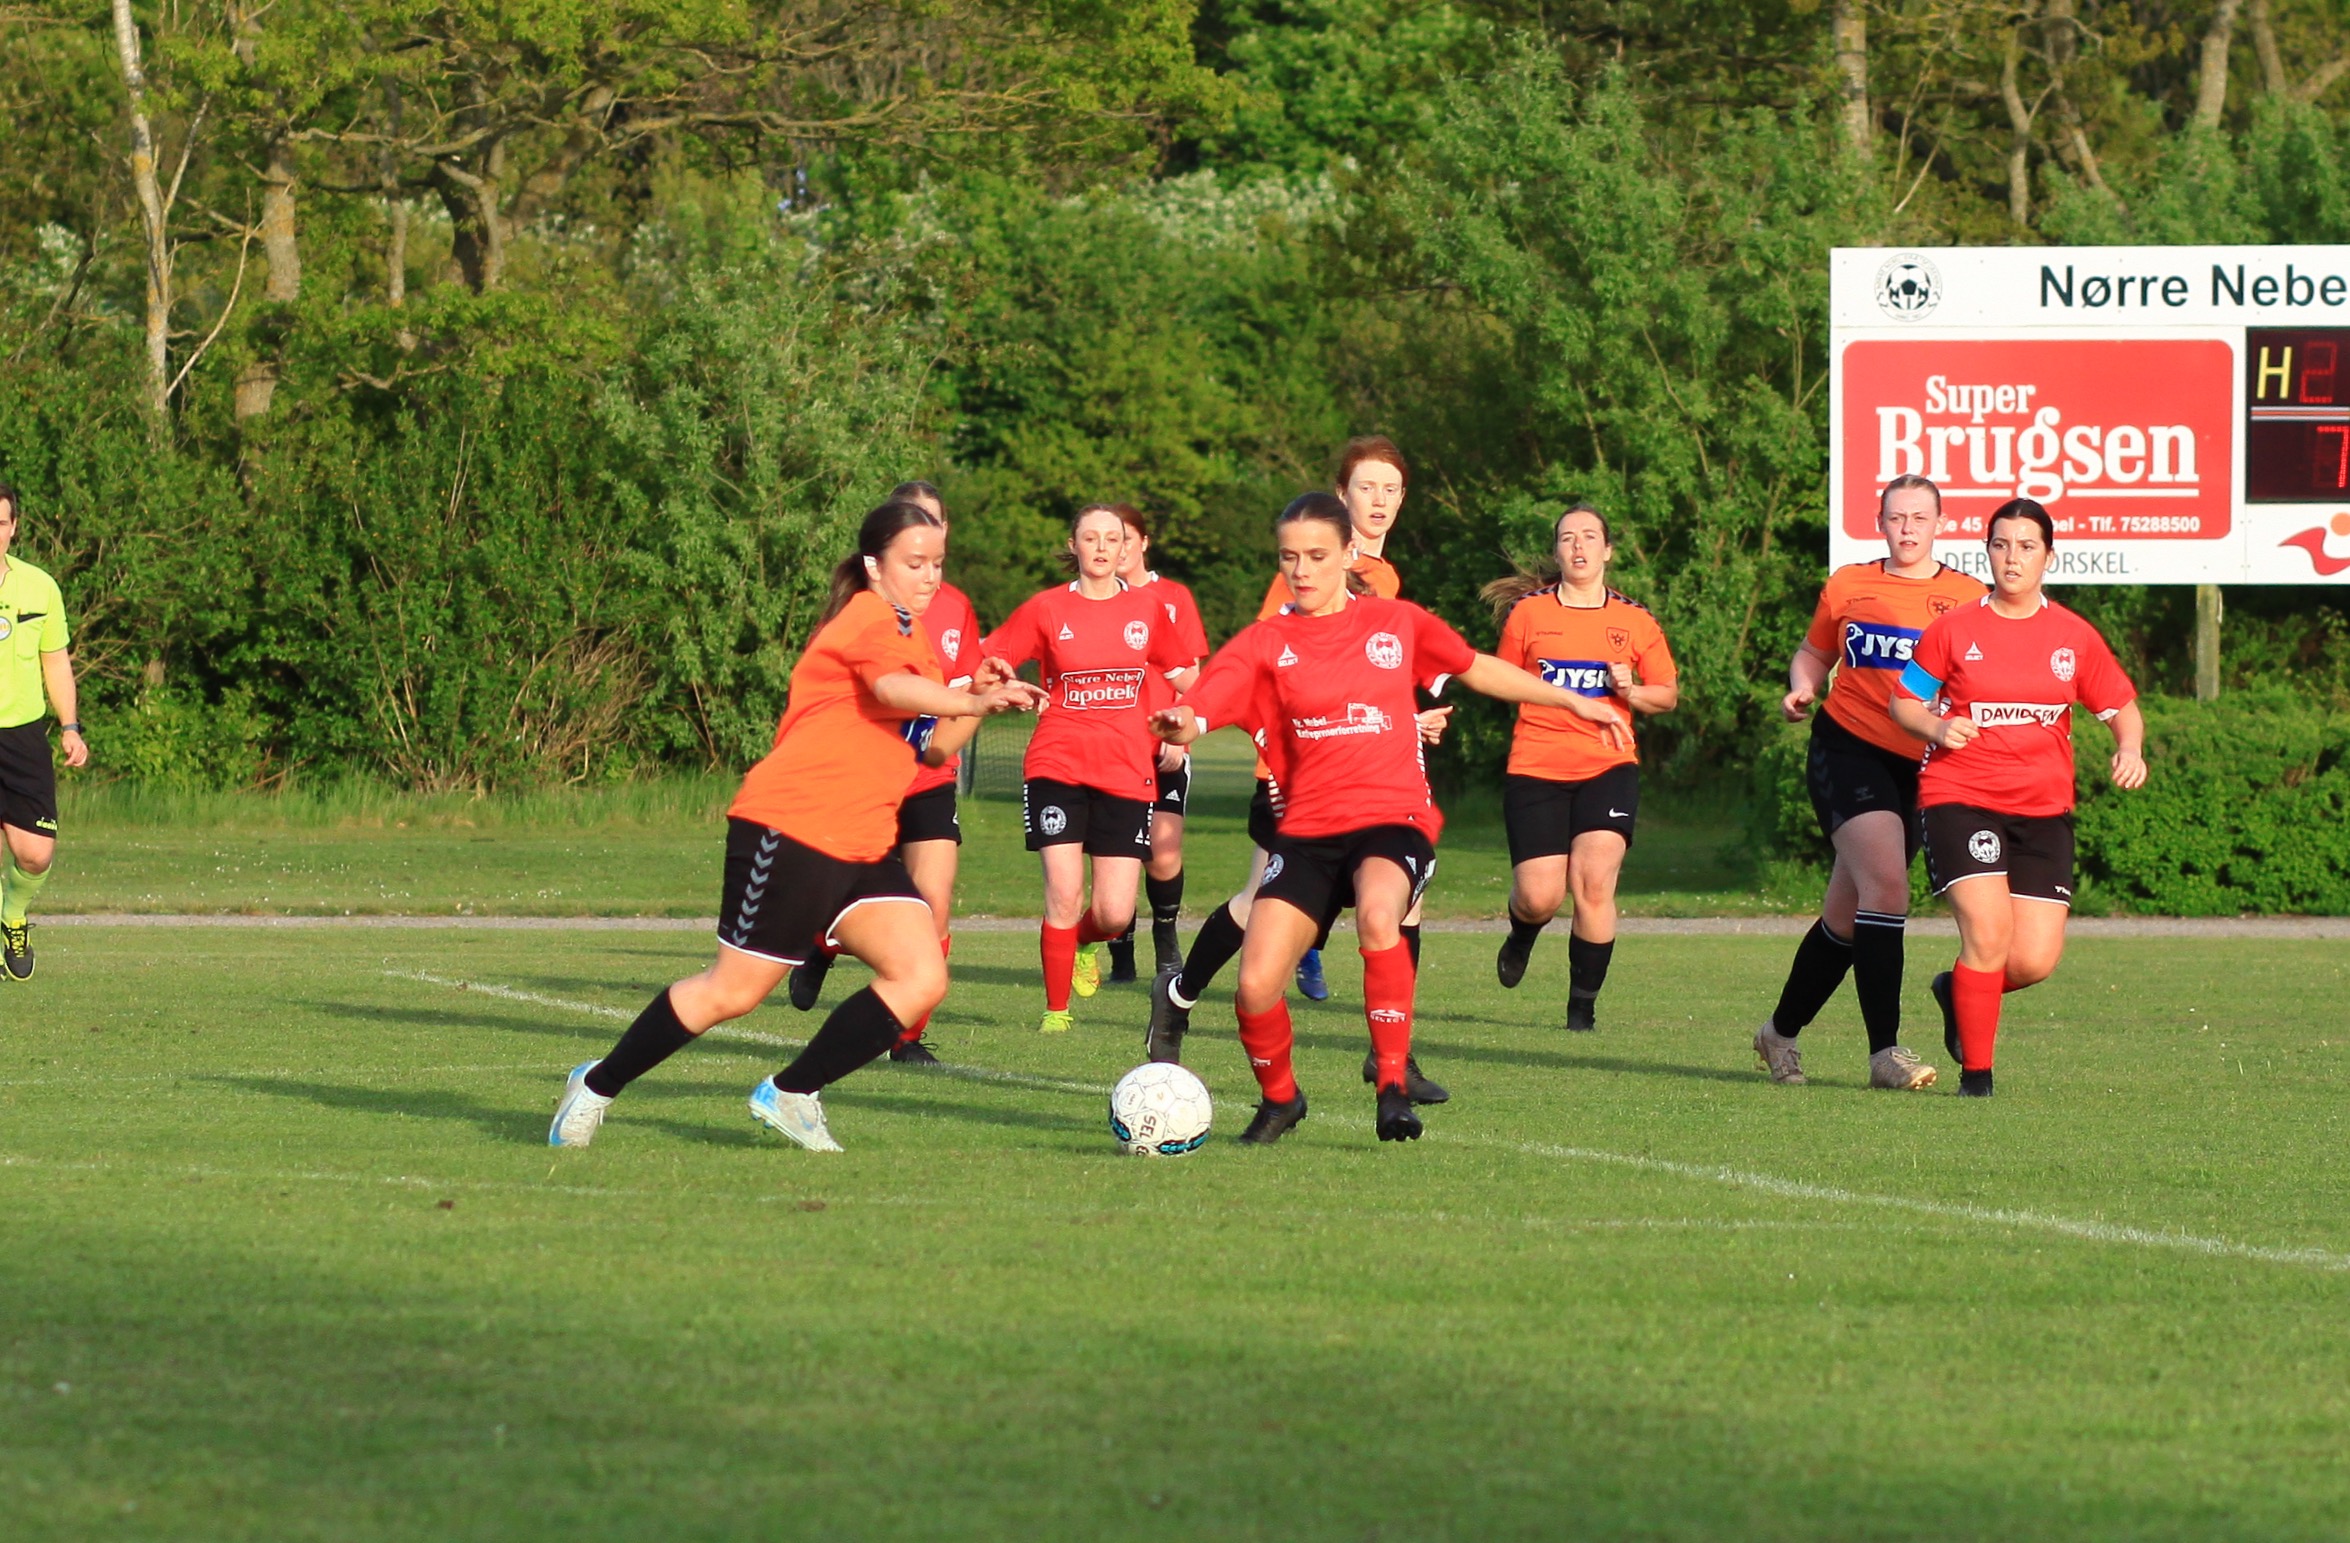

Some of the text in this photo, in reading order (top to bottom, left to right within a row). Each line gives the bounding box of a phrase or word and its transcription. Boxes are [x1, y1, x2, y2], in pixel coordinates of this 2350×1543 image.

[2041, 263, 2348, 308] Nørre Nebe
[2256, 345, 2293, 399] H
[1925, 374, 2037, 424] Super
[1875, 405, 2200, 506] Brugsen
[1961, 516, 1983, 532] 45
[2089, 516, 2116, 532] Tlf.
[2120, 516, 2200, 532] 75288500
[2046, 551, 2130, 575] ORSKEL
[1861, 633, 1920, 661] JYS
[1069, 684, 1136, 706] apotek
